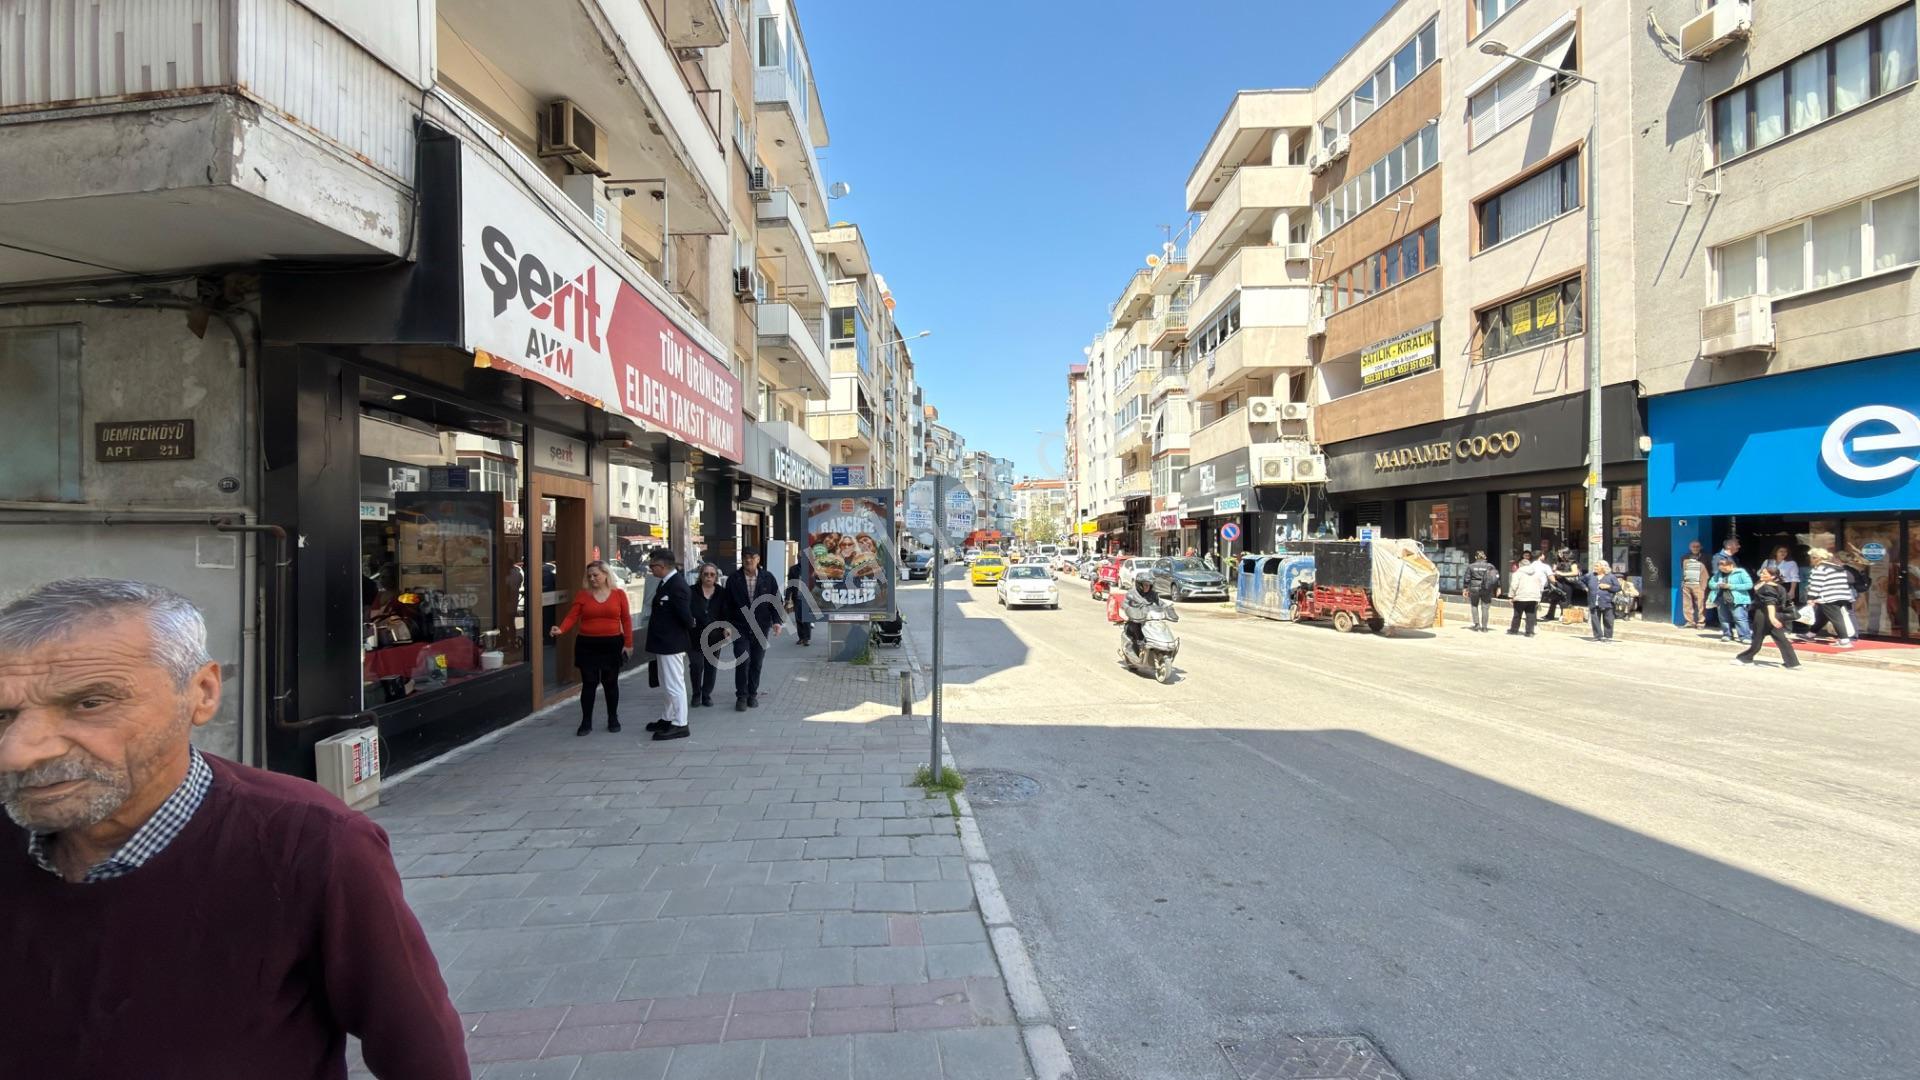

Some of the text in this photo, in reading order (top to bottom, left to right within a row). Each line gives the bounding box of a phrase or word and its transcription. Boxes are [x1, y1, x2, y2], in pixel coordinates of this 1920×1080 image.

[525, 327, 574, 379] AVM
[660, 328, 733, 414] TÜM ÜRÜNLERDE
[1362, 345, 1392, 367] SATILIK
[625, 363, 668, 425] ELDEN
[106, 446, 133, 457] APT
[1374, 430, 1521, 470] MADAME COCO
[1219, 498, 1240, 511] SIEMENS
